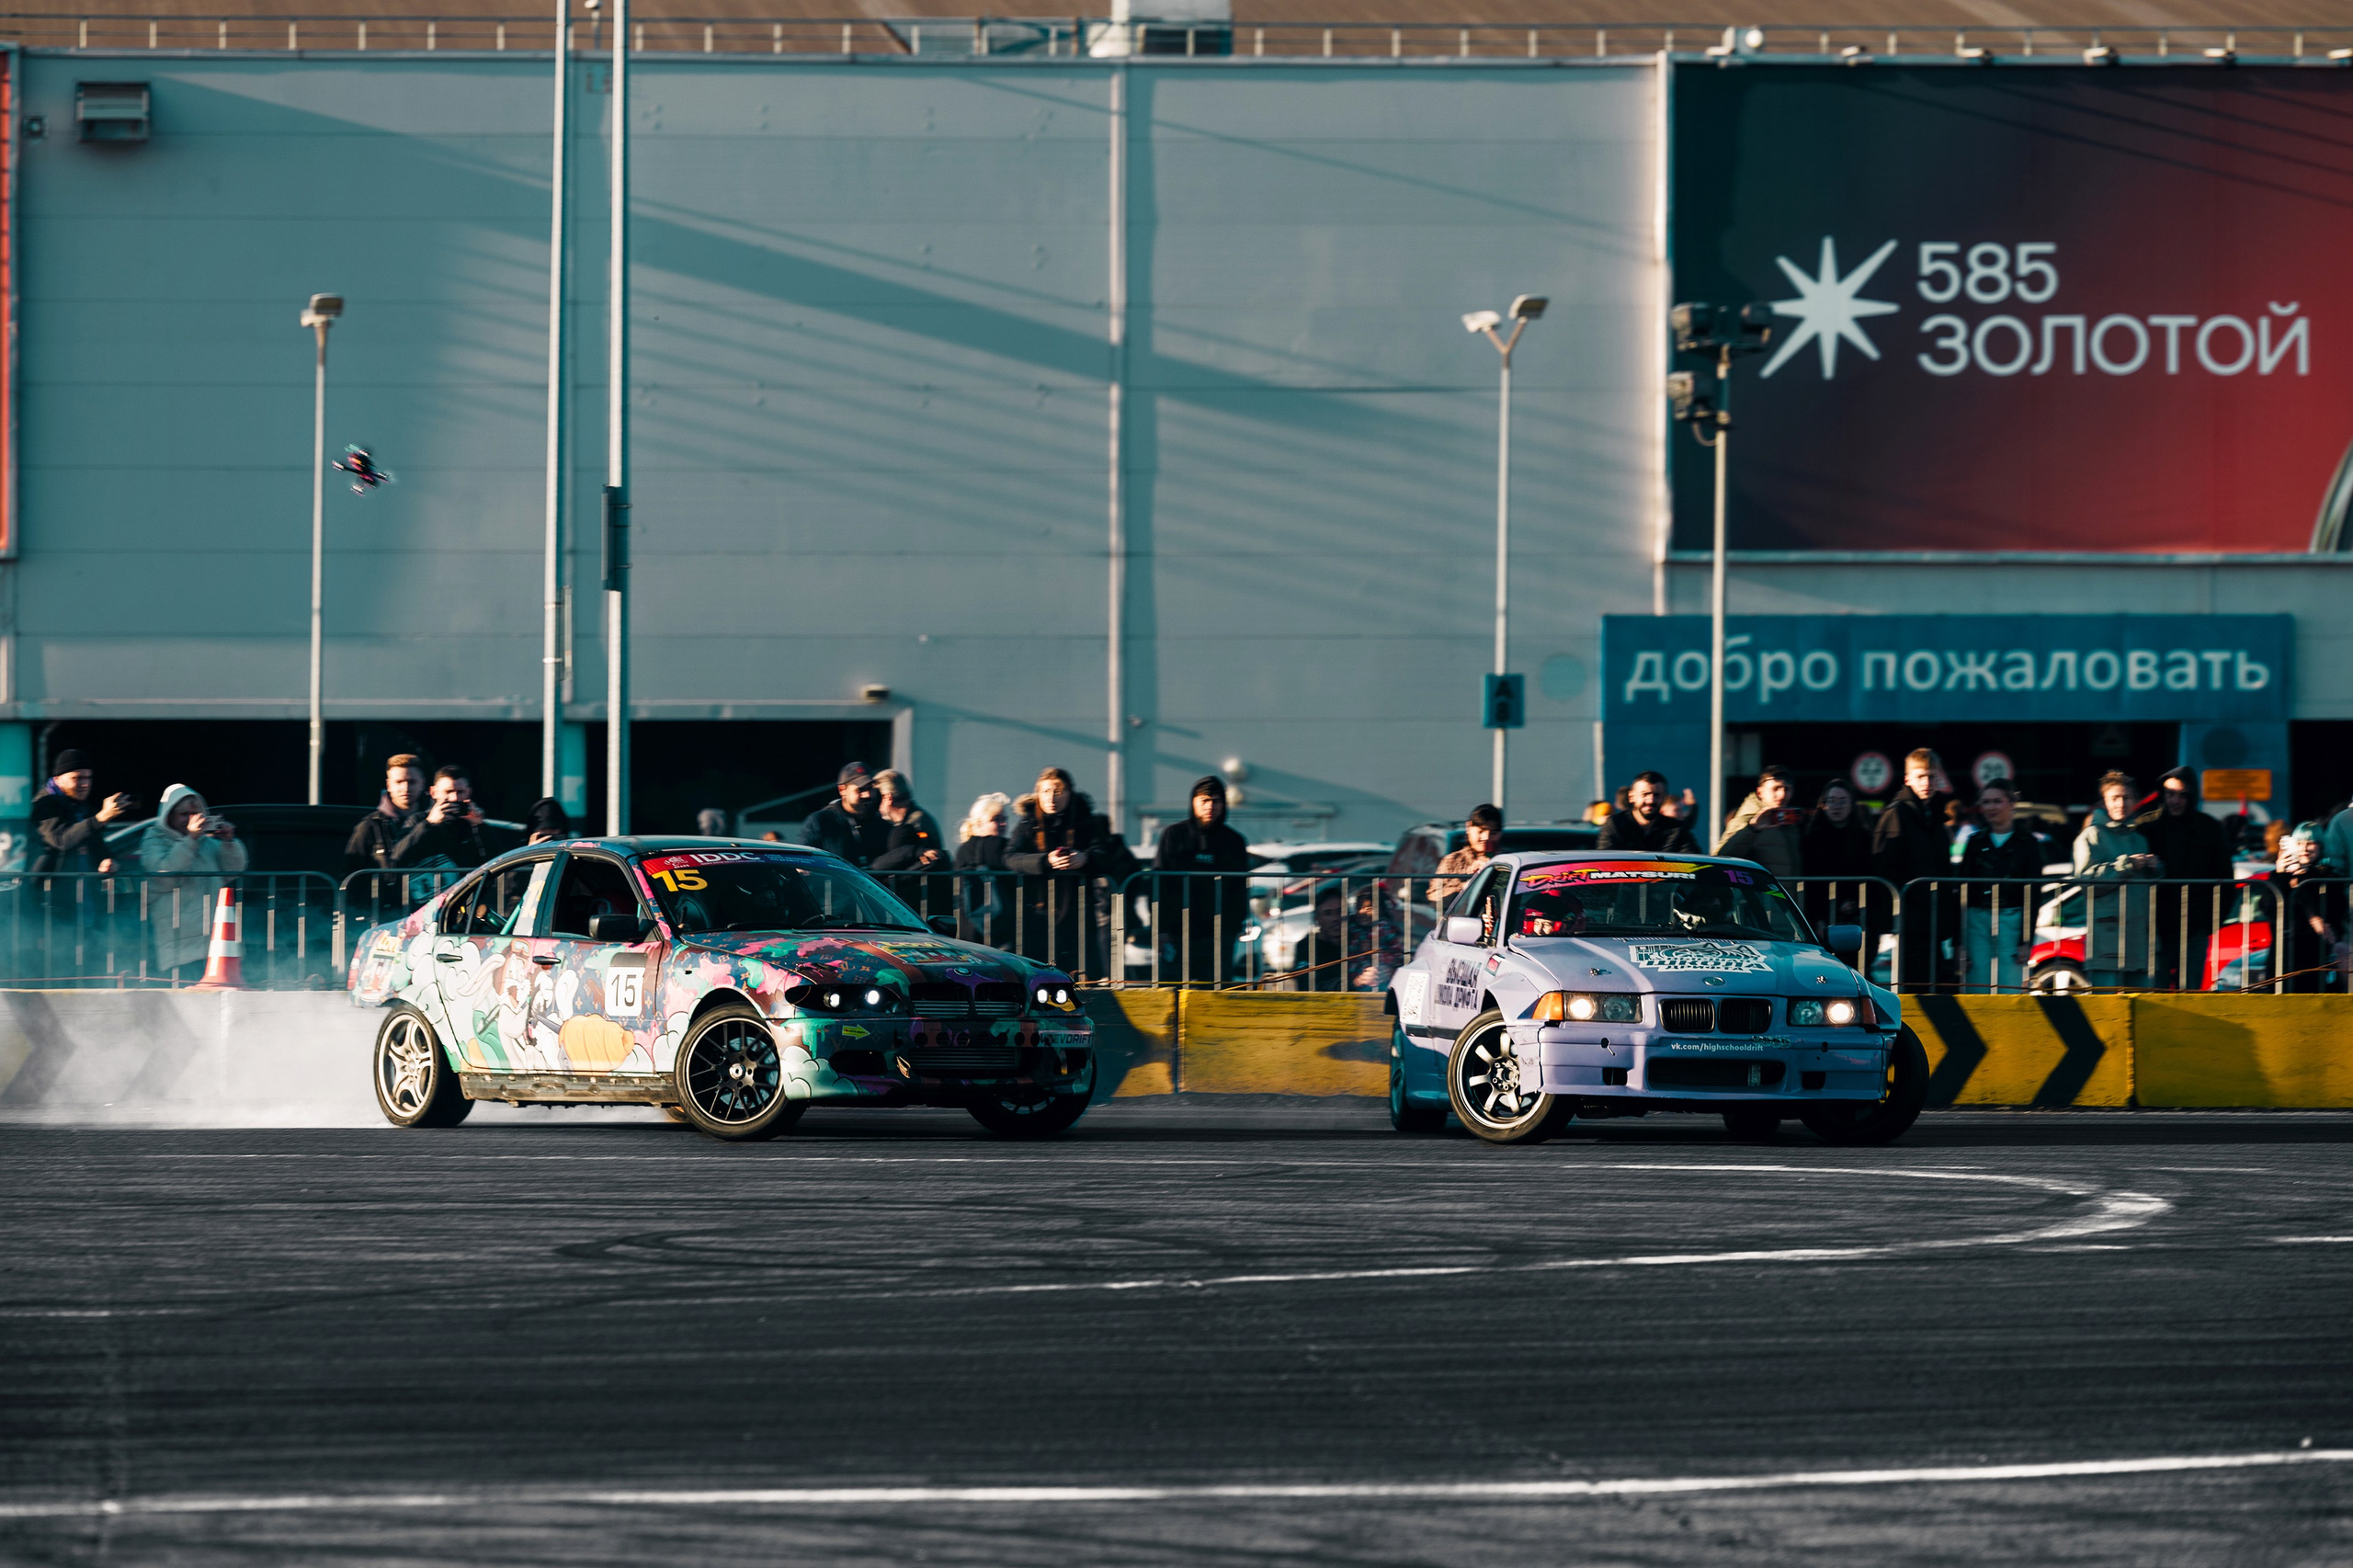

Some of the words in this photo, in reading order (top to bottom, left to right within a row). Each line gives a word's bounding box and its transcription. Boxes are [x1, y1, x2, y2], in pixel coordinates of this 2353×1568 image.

[1916, 241, 2060, 304] 585
[1916, 301, 2311, 377] ЗОЛОТОЙ
[1625, 634, 1838, 703] добро
[1862, 648, 2269, 691] пожаловать
[689, 852, 761, 863] IDDC
[652, 869, 708, 892] 15
[1590, 871, 1696, 880] MATSURI
[1723, 869, 1754, 885] 15
[611, 974, 636, 1006] 15
[1671, 1042, 1763, 1052] vk.com/highschooldrift
